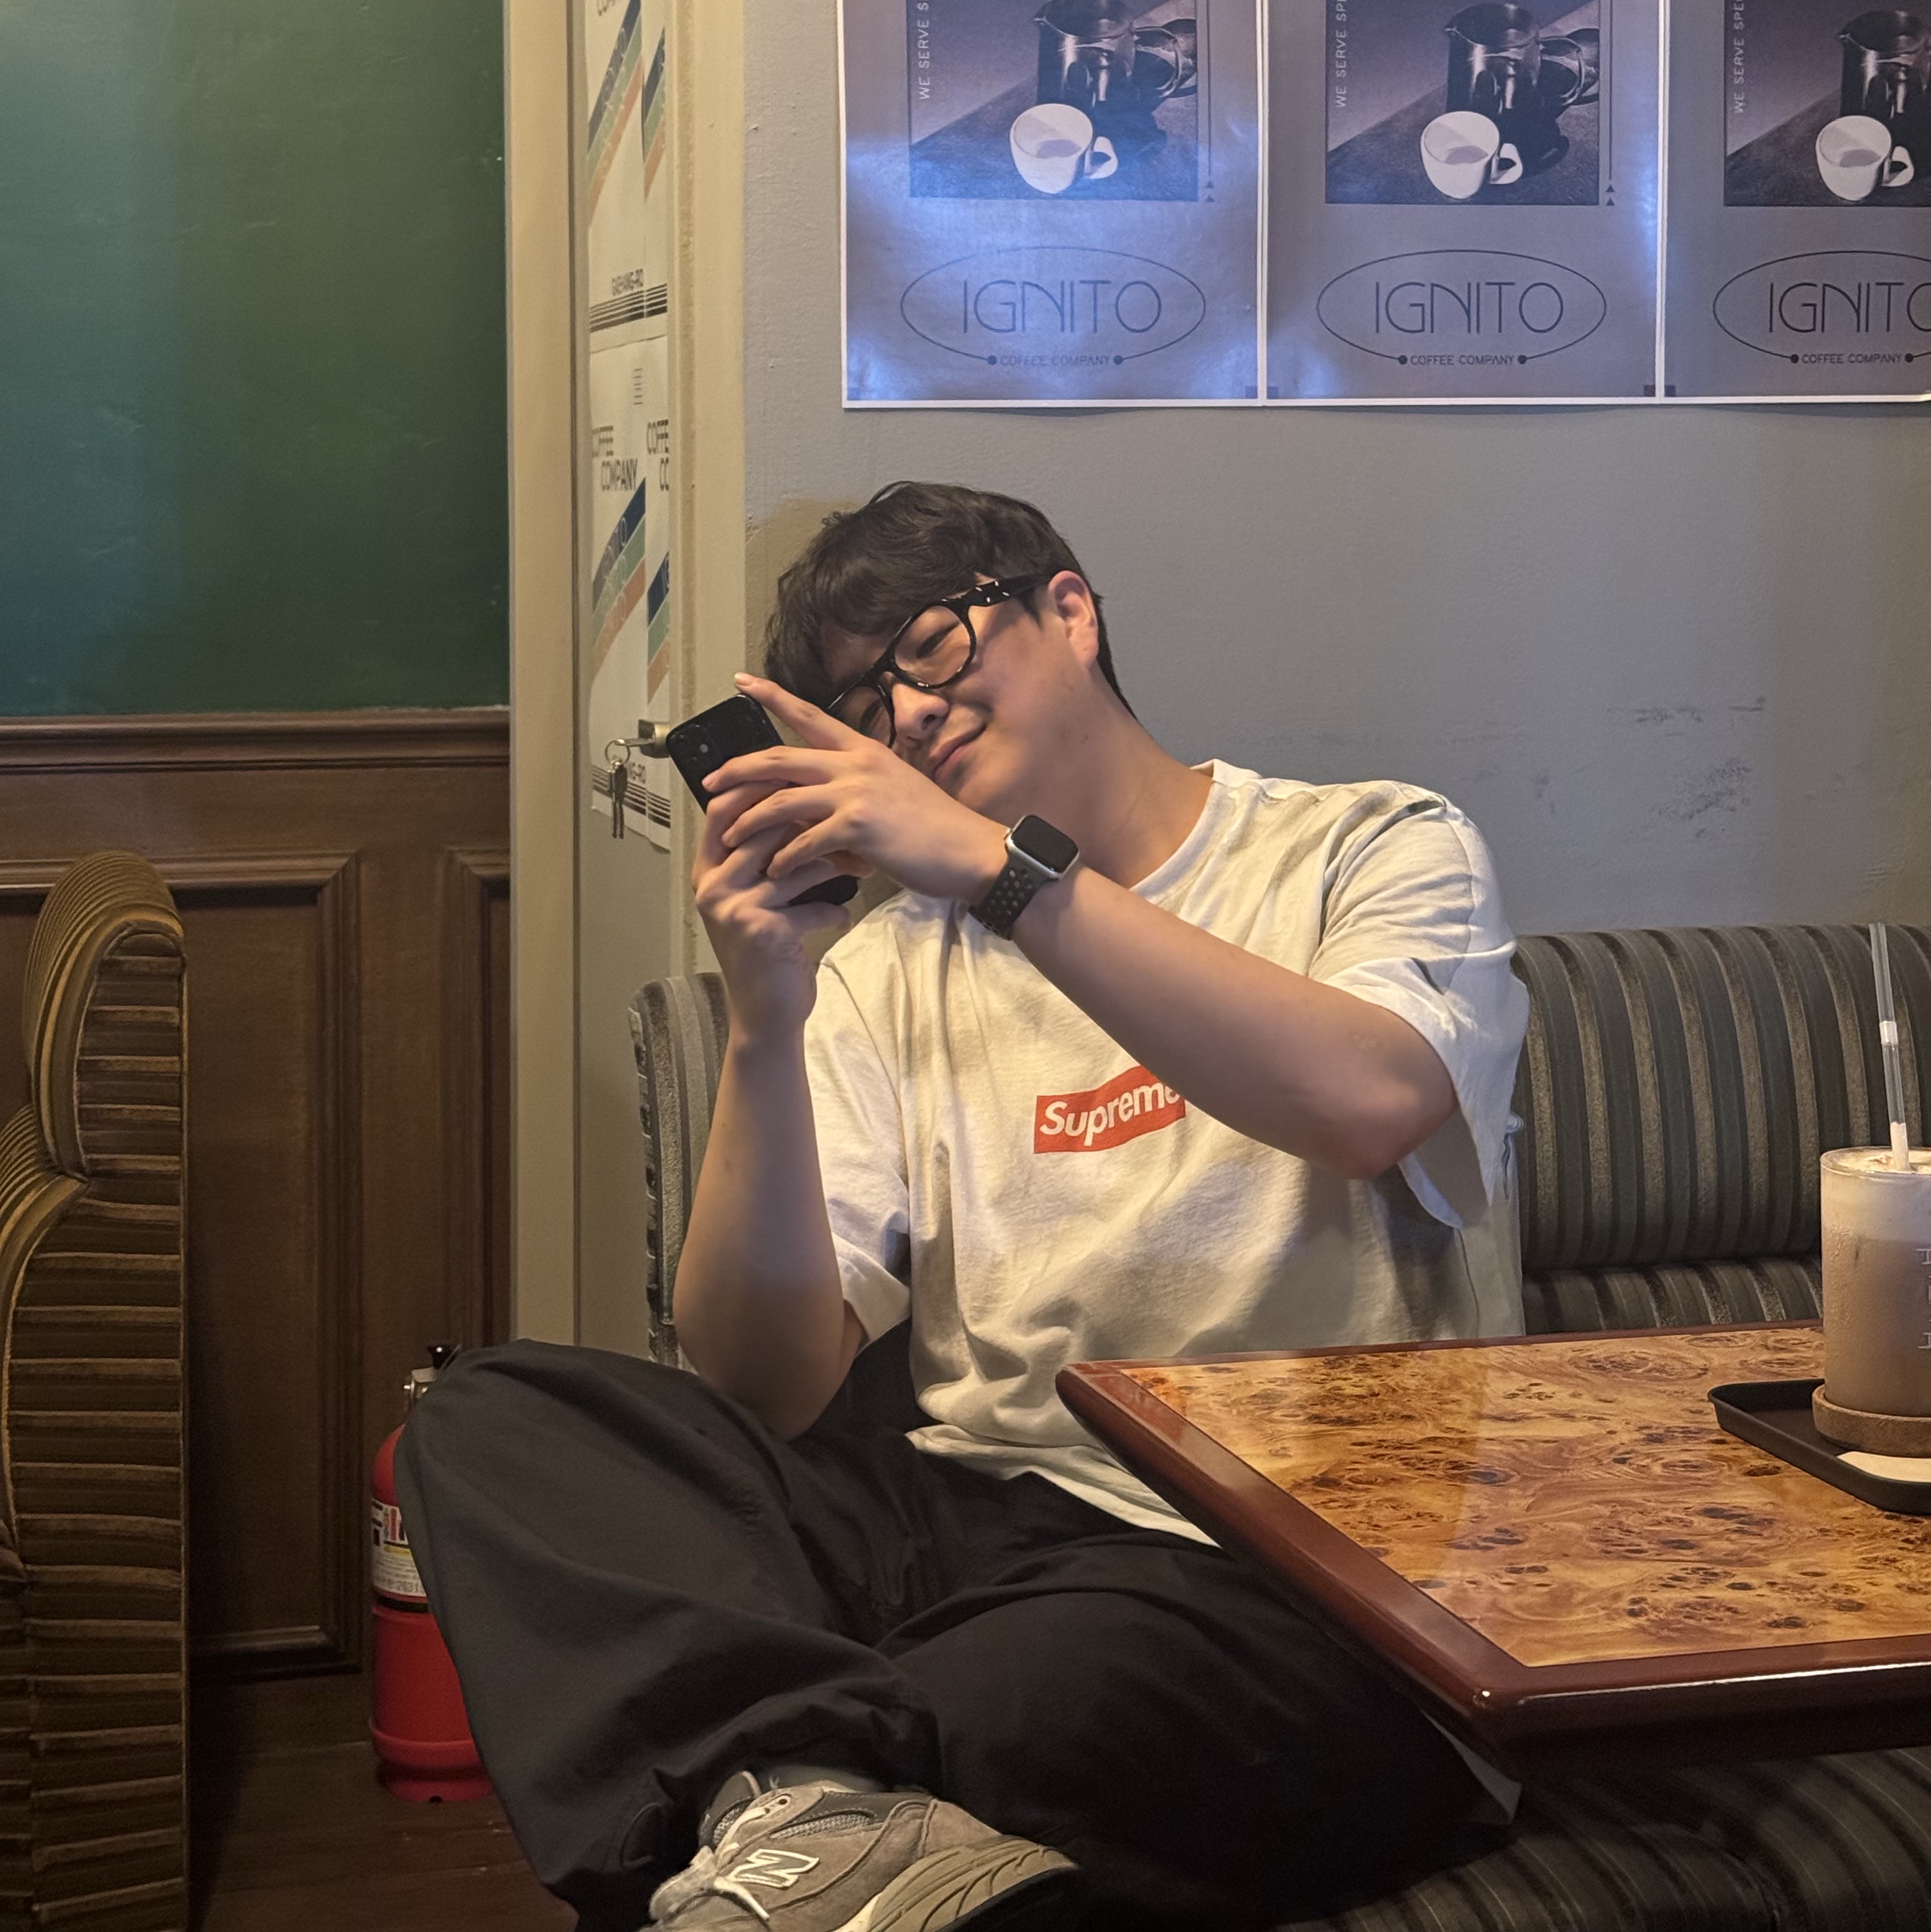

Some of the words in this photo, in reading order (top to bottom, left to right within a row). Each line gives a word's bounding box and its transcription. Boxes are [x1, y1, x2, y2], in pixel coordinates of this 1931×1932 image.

[917, 0, 929, 10] S
[1336, 0, 1347, 22] SP
[1733, 0, 1744, 29] SPE
[917, 19, 930, 68] SERVE
[1336, 30, 1347, 78] SERVE
[1733, 37, 1745, 84] SERVE
[918, 77, 931, 100] WE
[1336, 86, 1347, 108] WE
[1733, 92, 1745, 114] WE
[963, 280, 1162, 334] IGNITO
[1375, 282, 1564, 334] IGNITO
[1000, 355, 1048, 366] COFFEE
[1051, 355, 1110, 366] COMPANY
[1410, 355, 1454, 365] COFFEE
[1459, 355, 1515, 365] COMPANY
[1801, 354, 1845, 364] COFFEE
[1848, 353, 1902, 364] COMPANY
